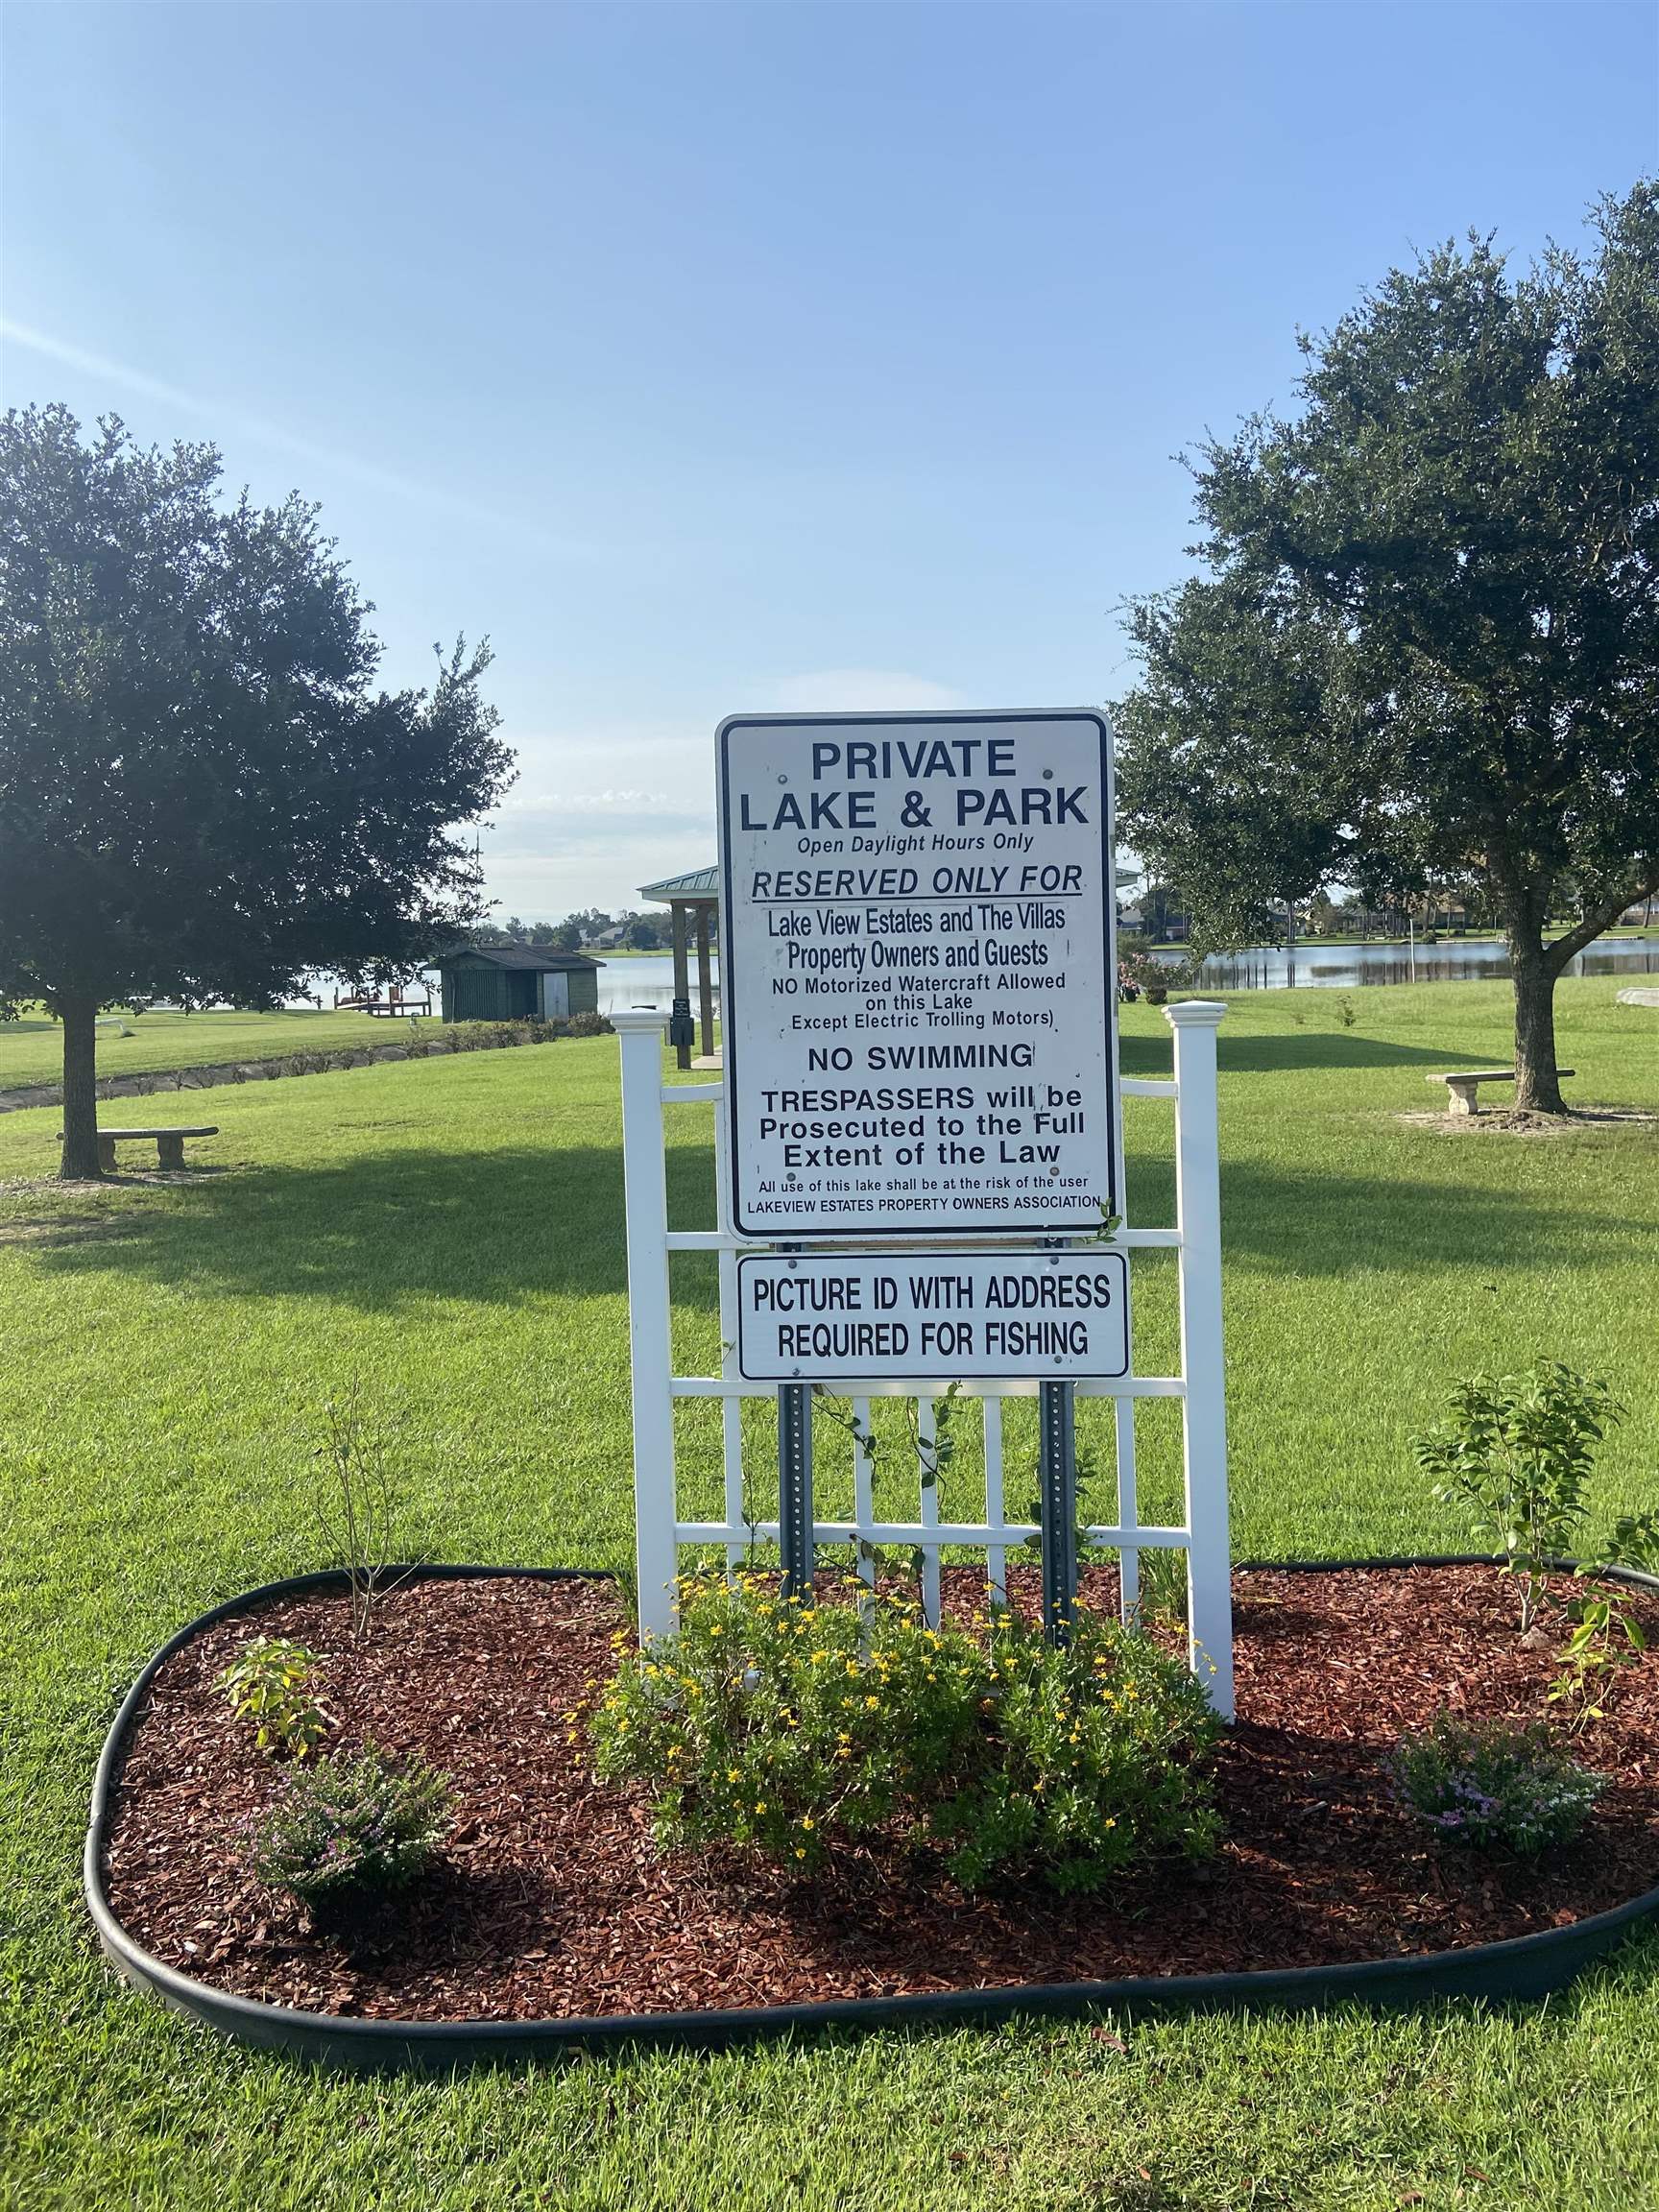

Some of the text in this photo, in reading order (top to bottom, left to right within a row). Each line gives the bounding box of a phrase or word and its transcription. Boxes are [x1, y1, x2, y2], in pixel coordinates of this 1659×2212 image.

[812, 739, 1017, 781] PRIVATE
[740, 786, 1089, 830] LAKE & PARK
[798, 832, 1034, 857] Open Daylight Hours Only
[753, 865, 1083, 898] RESERVED ONLY FOR
[769, 902, 1066, 937] Lake View Estates and The Villas
[787, 939, 1048, 974] Property Owners and Guests
[773, 973, 1066, 995] NO Motorized Watercraft Allowed
[866, 994, 973, 1010] on this Lake
[792, 1009, 1054, 1032] Except Electric Trolling Motors)
[808, 1044, 1032, 1071] NO SWIMMING
[761, 1085, 1082, 1113] TRESPASSERS will be
[760, 1112, 1084, 1140] Prosecuted to the Full
[783, 1141, 1060, 1167] Extent of the Law
[759, 1176, 1088, 1192] All use of this lake shall be at the risk of the user
[748, 1195, 1100, 1214] LAKEVIEW ESTATES PROPERTY OWNERS ASSOCIATION
[755, 1274, 1111, 1311] PICTURE ID WITH ADDRESS
[779, 1321, 1088, 1358] REQUIRED FOR FISHING
